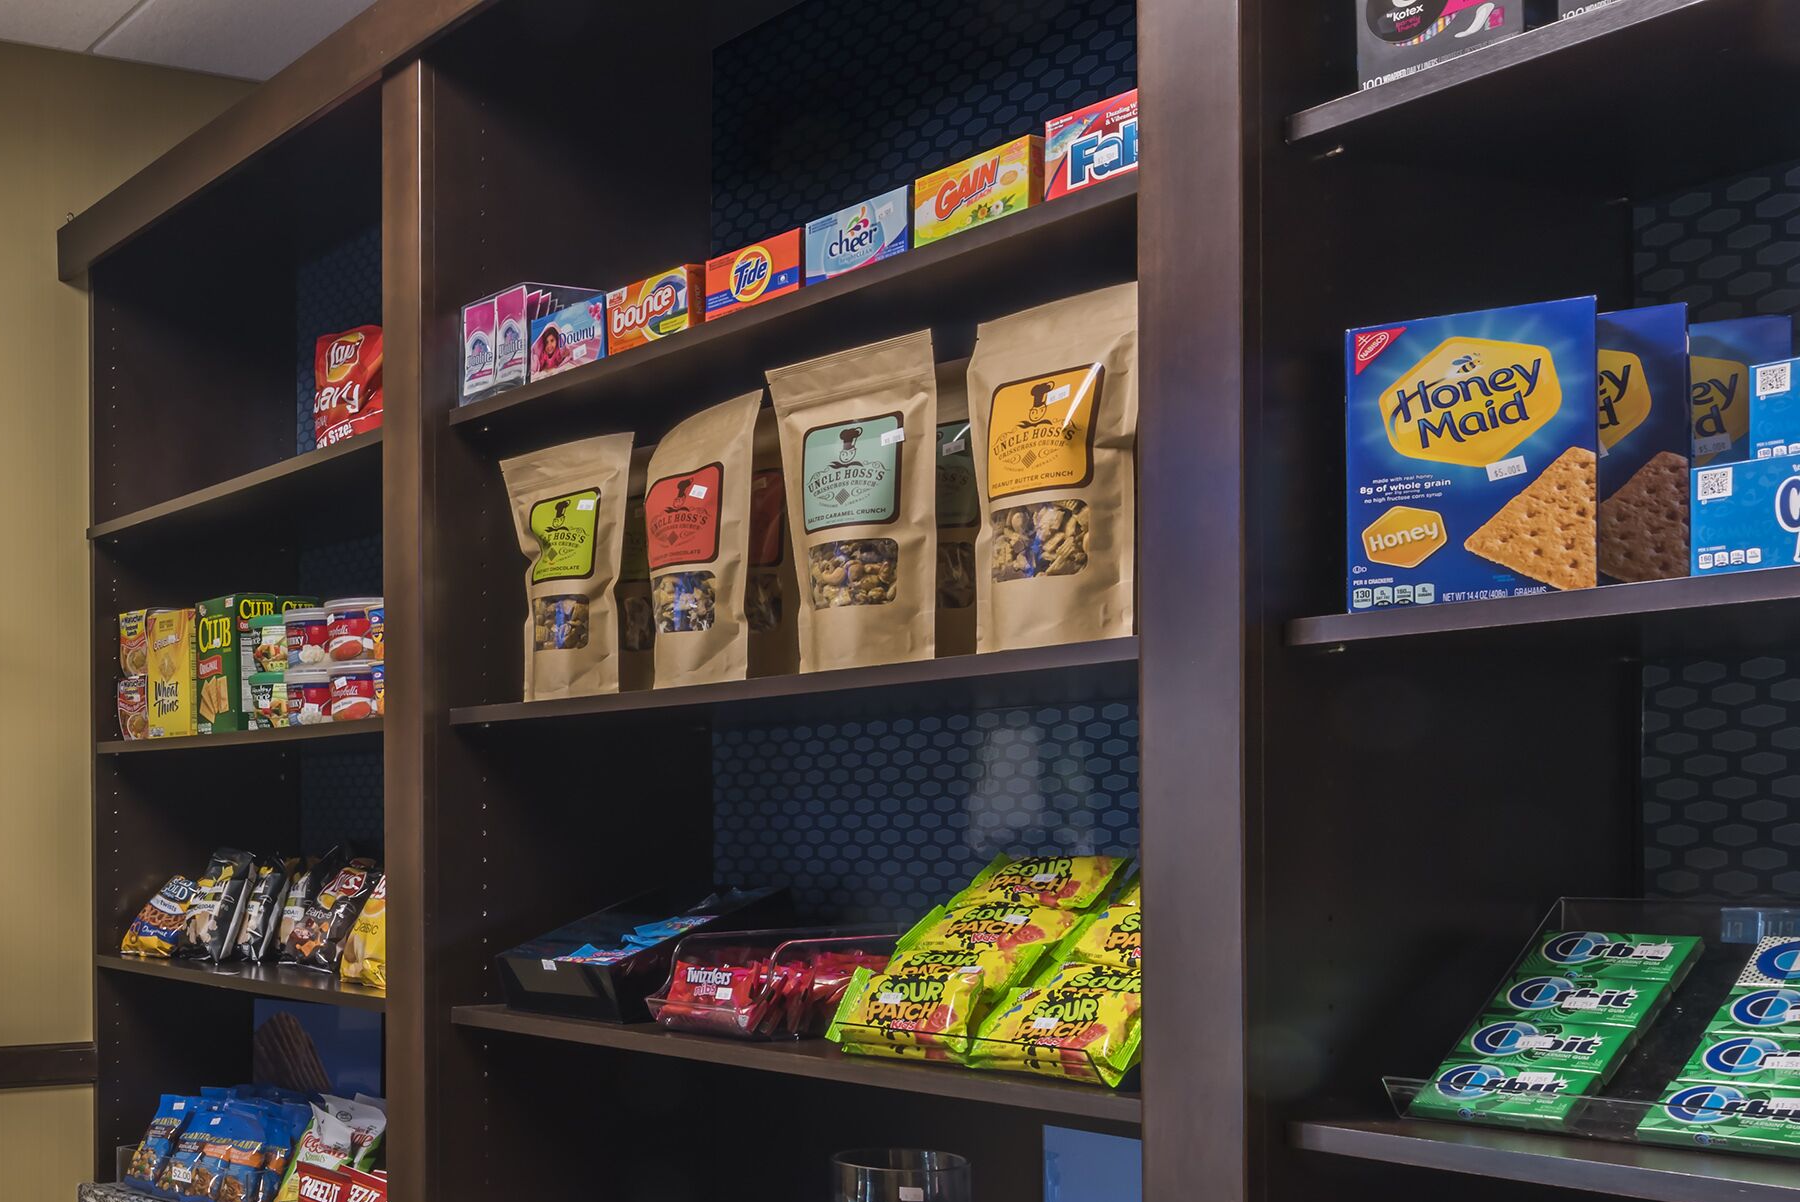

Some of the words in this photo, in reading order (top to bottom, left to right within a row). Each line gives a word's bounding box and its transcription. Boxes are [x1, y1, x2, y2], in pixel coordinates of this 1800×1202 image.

[1392, 4, 1424, 21] Kotex
[1362, 77, 1384, 91] 100
[935, 155, 1000, 221] GAIN
[829, 226, 878, 257] cheer
[733, 258, 768, 296] Tide
[612, 286, 673, 334] bounce
[558, 324, 596, 349] Downy
[1359, 333, 1388, 360] NABISCO
[1390, 358, 1542, 425] Honey
[1417, 391, 1531, 449] Maid
[993, 431, 1029, 456] UNCLE
[1032, 427, 1076, 441] HOSS'S
[998, 441, 1037, 461] CRISSCROSS
[808, 470, 841, 494] UNCLE
[844, 468, 886, 482] HOSS'S
[813, 480, 850, 497] CRISSCROSS
[850, 479, 876, 487] CRUNCH
[991, 479, 1013, 490] PEANUT
[1015, 474, 1039, 485] BUTTER
[1040, 470, 1074, 479] CRUNCH
[1359, 486, 1373, 495] 8g
[1375, 484, 1387, 493] of
[1389, 481, 1421, 491] whole
[1424, 479, 1451, 489] grain
[1372, 477, 1388, 485] made
[1389, 475, 1403, 483] with
[1415, 474, 1434, 482] honey
[1372, 496, 1386, 504] high
[1387, 494, 1411, 502] fructose
[1426, 491, 1443, 499] syrup
[675, 513, 709, 526] HOSS'S
[808, 515, 825, 524] SALTED
[825, 510, 855, 520] CARAMEL
[856, 507, 887, 515] CRUNCH
[553, 532, 586, 544] HOSS'S
[1368, 521, 1440, 553] Honey
[1368, 577, 1394, 585] CRACKERS
[1355, 590, 1370, 598] 130
[1442, 593, 1455, 602] NET
[1456, 592, 1466, 600] WT
[1466, 591, 1480, 600] 14.4
[1480, 591, 1488, 599] OZ
[1514, 586, 1547, 596] GRAHAMS
[240, 599, 274, 620] CLUB
[199, 617, 232, 653] CLUB
[154, 681, 179, 701] Wheat
[153, 699, 179, 718] Thins
[1005, 859, 1072, 877] SOUR
[990, 875, 1069, 892] PATCH
[961, 907, 1033, 923] SOUR
[947, 920, 1023, 936] PATCH
[970, 933, 999, 943] Kids
[913, 952, 979, 966] SOUR
[685, 966, 732, 986] Twizzlers
[876, 980, 944, 1003] SOUR
[1507, 975, 1637, 1011] Orbit
[867, 1001, 940, 1021] PATCH
[1029, 997, 1098, 1022] SOUR
[890, 1019, 918, 1030] Kids
[1015, 1020, 1095, 1040] PATCH
[1434, 1064, 1566, 1100] Orbit
[1740, 1119, 1785, 1129] SPEARMINT
[173, 1168, 191, 1181] $2.00
